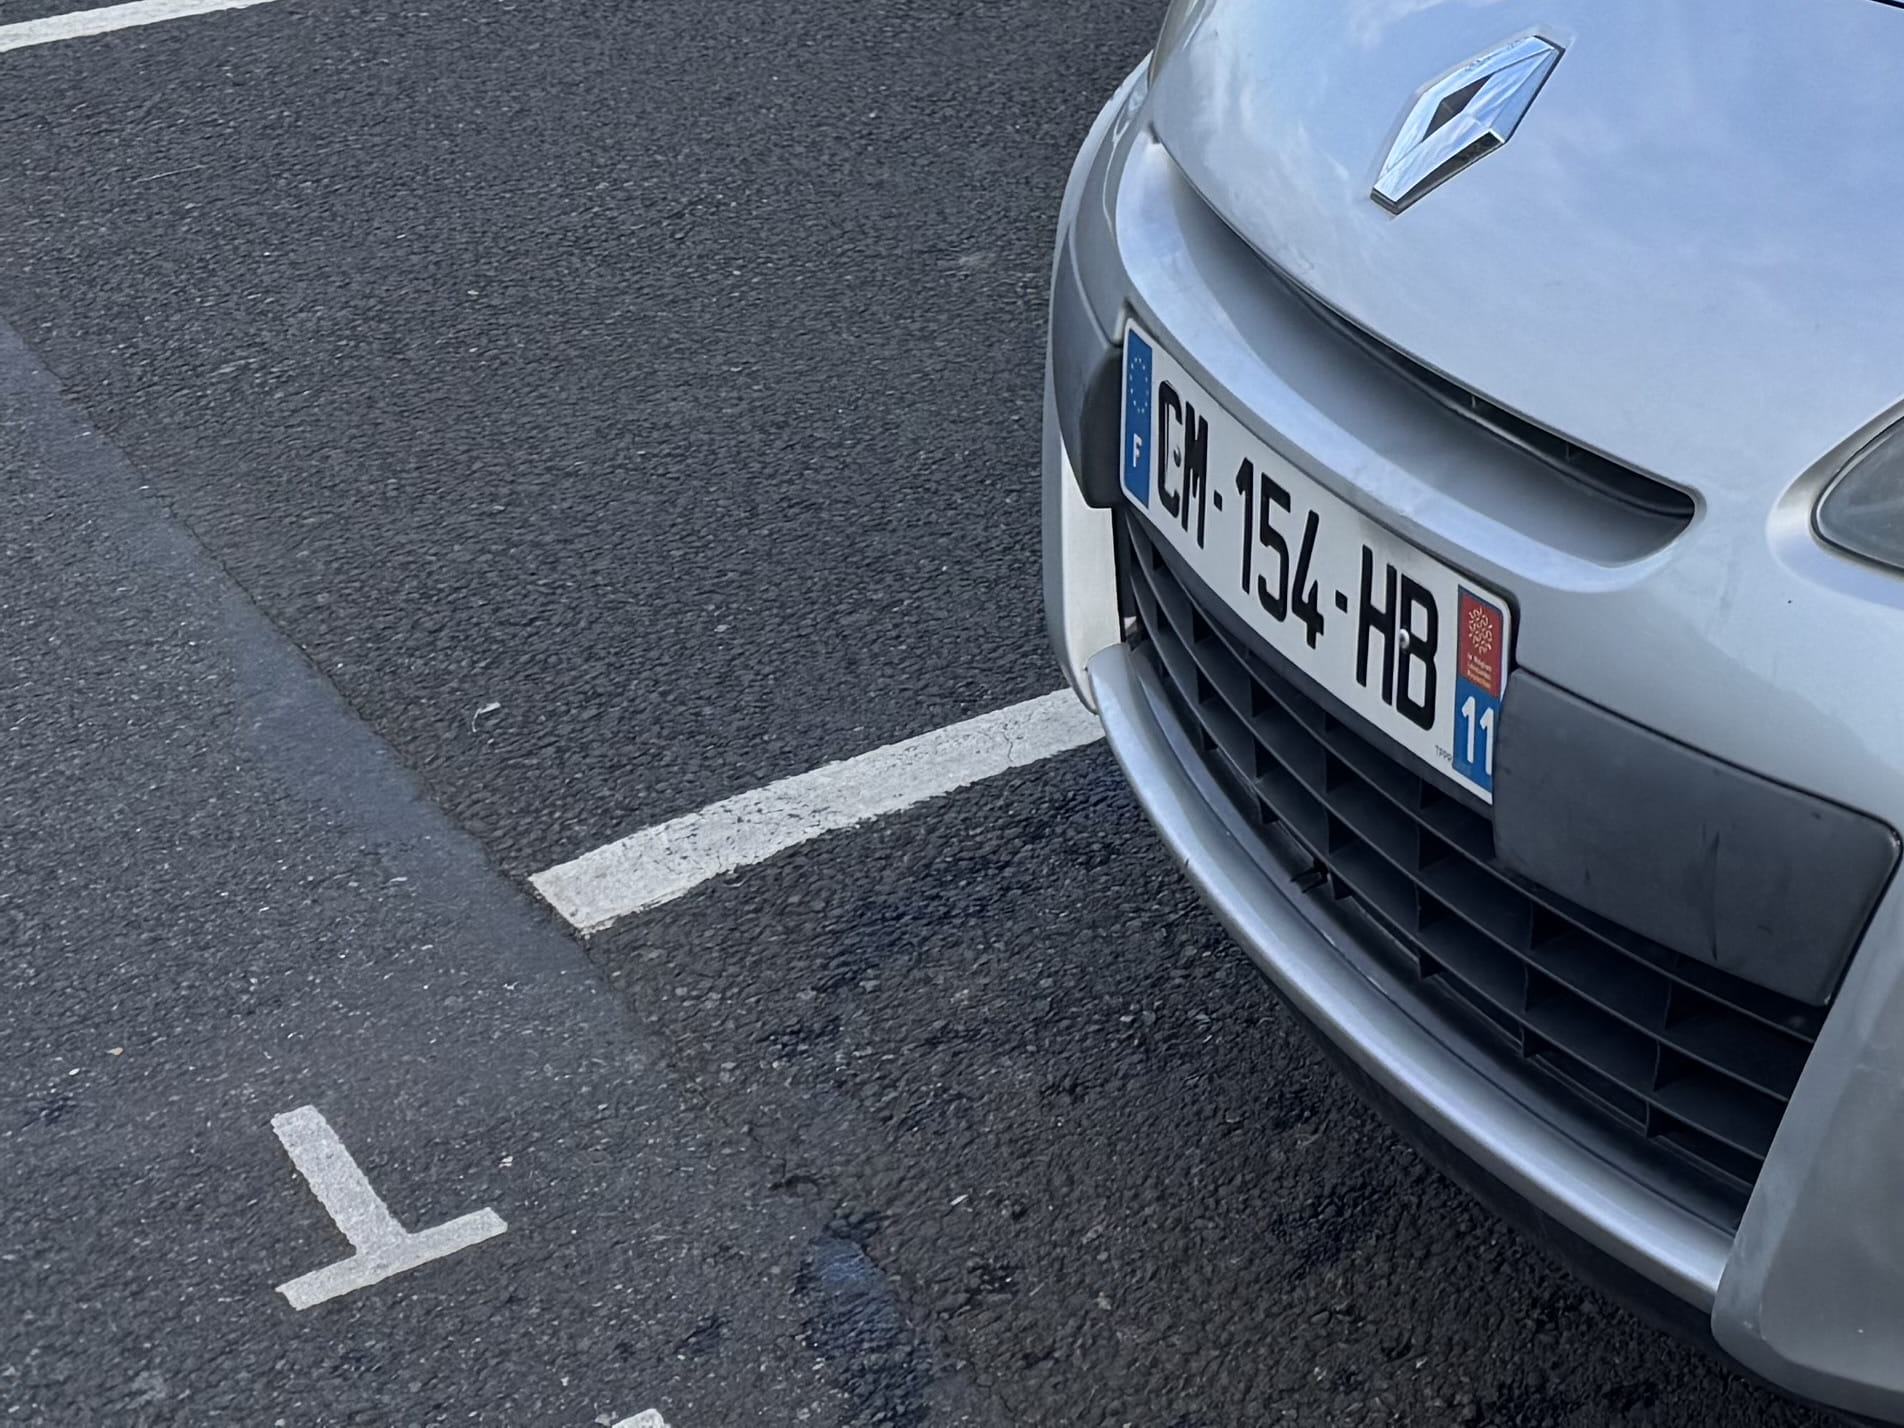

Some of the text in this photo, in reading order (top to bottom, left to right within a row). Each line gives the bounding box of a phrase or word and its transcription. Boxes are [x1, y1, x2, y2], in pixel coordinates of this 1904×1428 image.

[1132, 433, 1142, 468] F
[1158, 380, 1438, 730] CM-154-HB
[1461, 696, 1494, 775] 11
